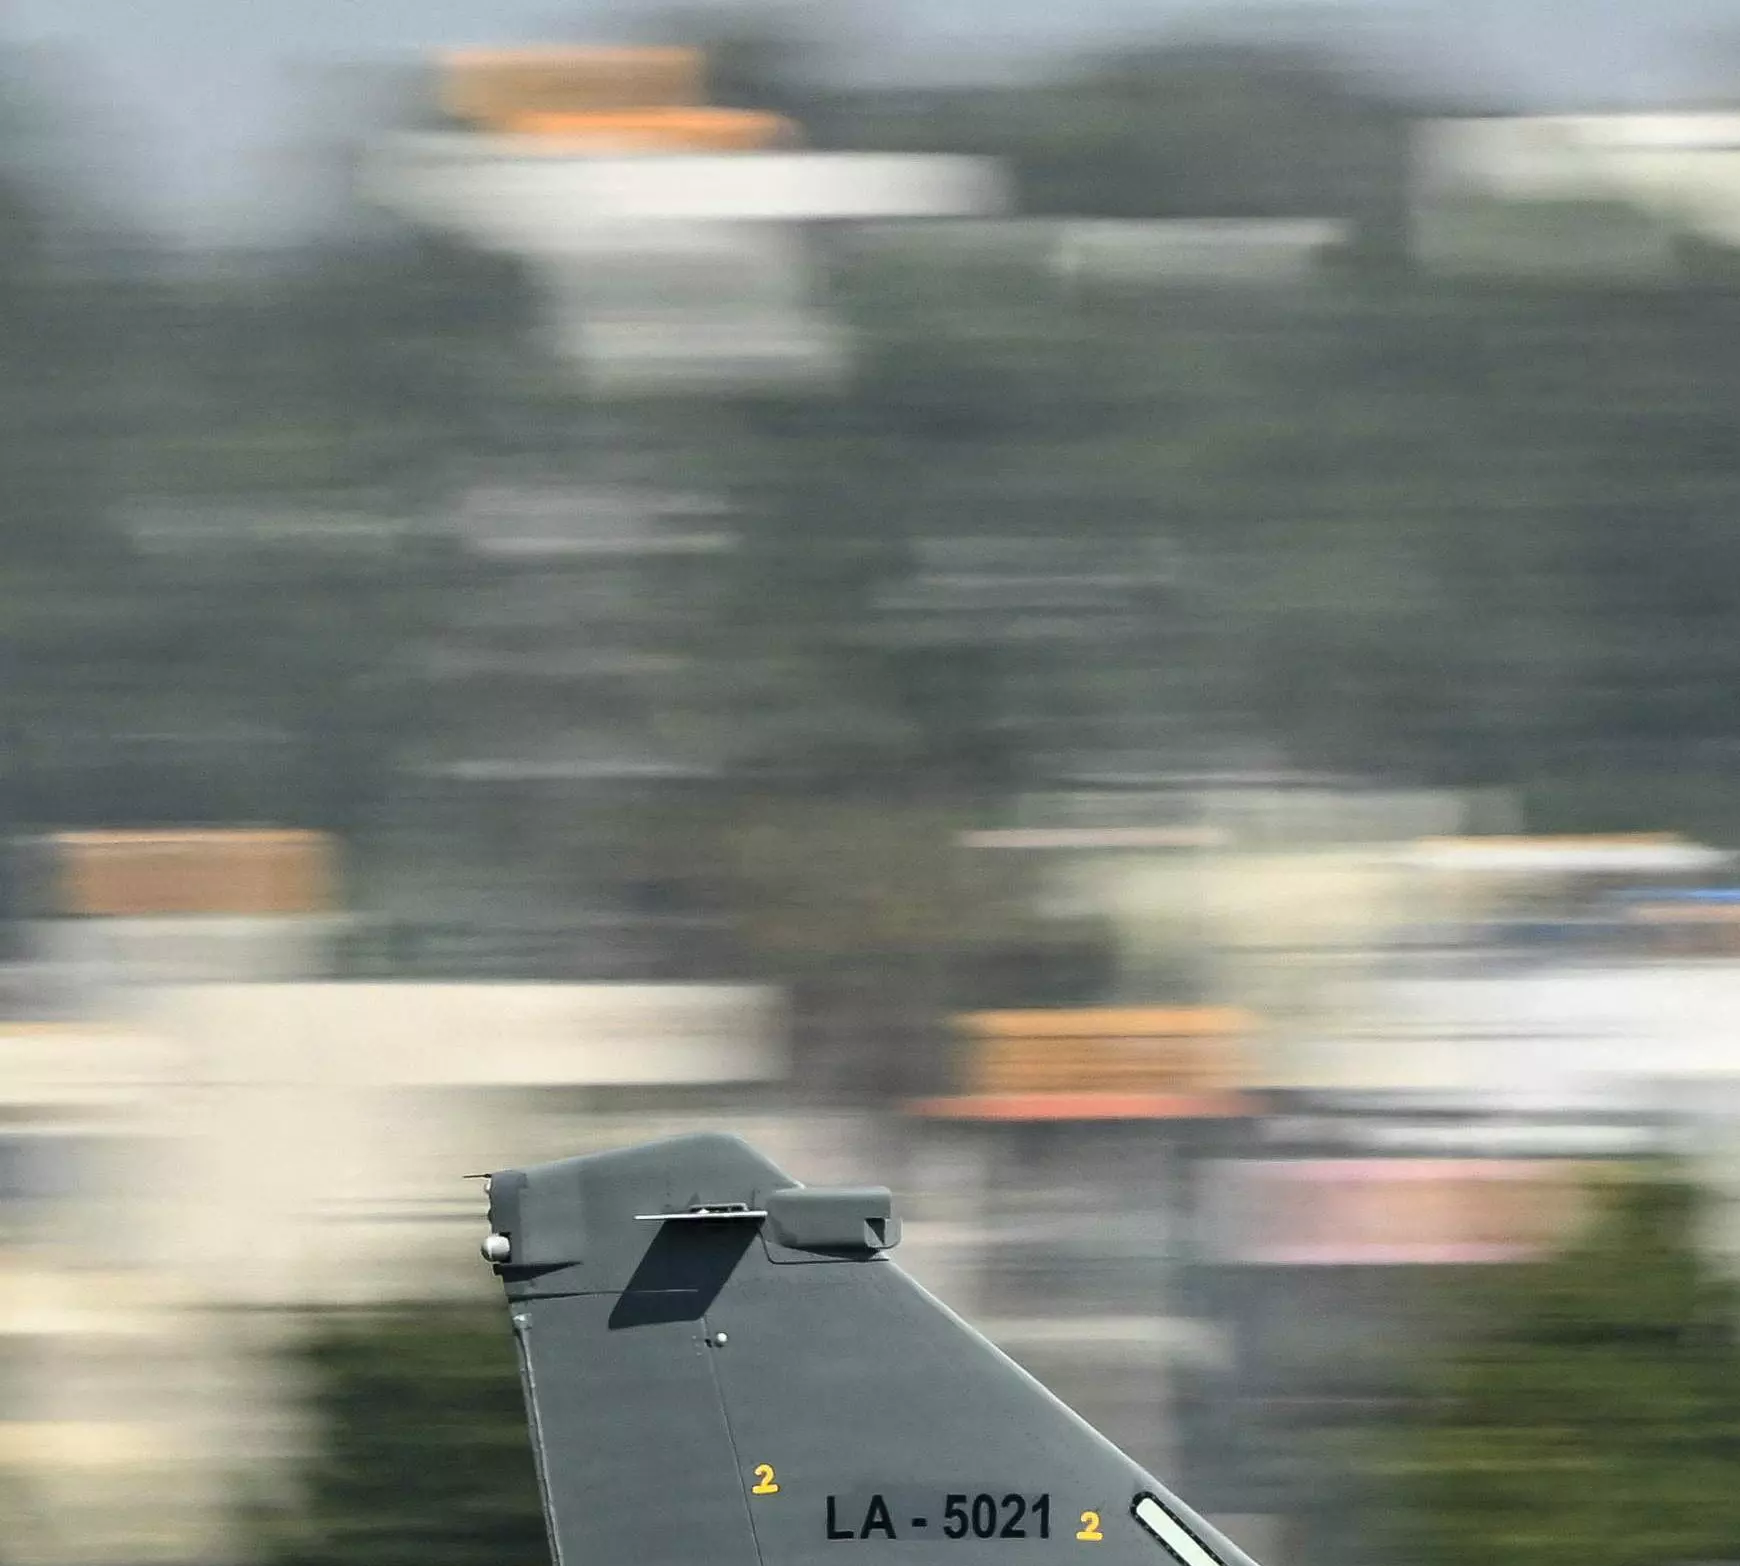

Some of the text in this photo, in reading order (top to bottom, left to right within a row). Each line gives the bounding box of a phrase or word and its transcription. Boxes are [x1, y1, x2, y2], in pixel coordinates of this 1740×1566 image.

[752, 1463, 780, 1494] 2
[826, 1494, 896, 1540] LA
[943, 1493, 1050, 1540] 5021
[1076, 1510, 1104, 1541] 2
